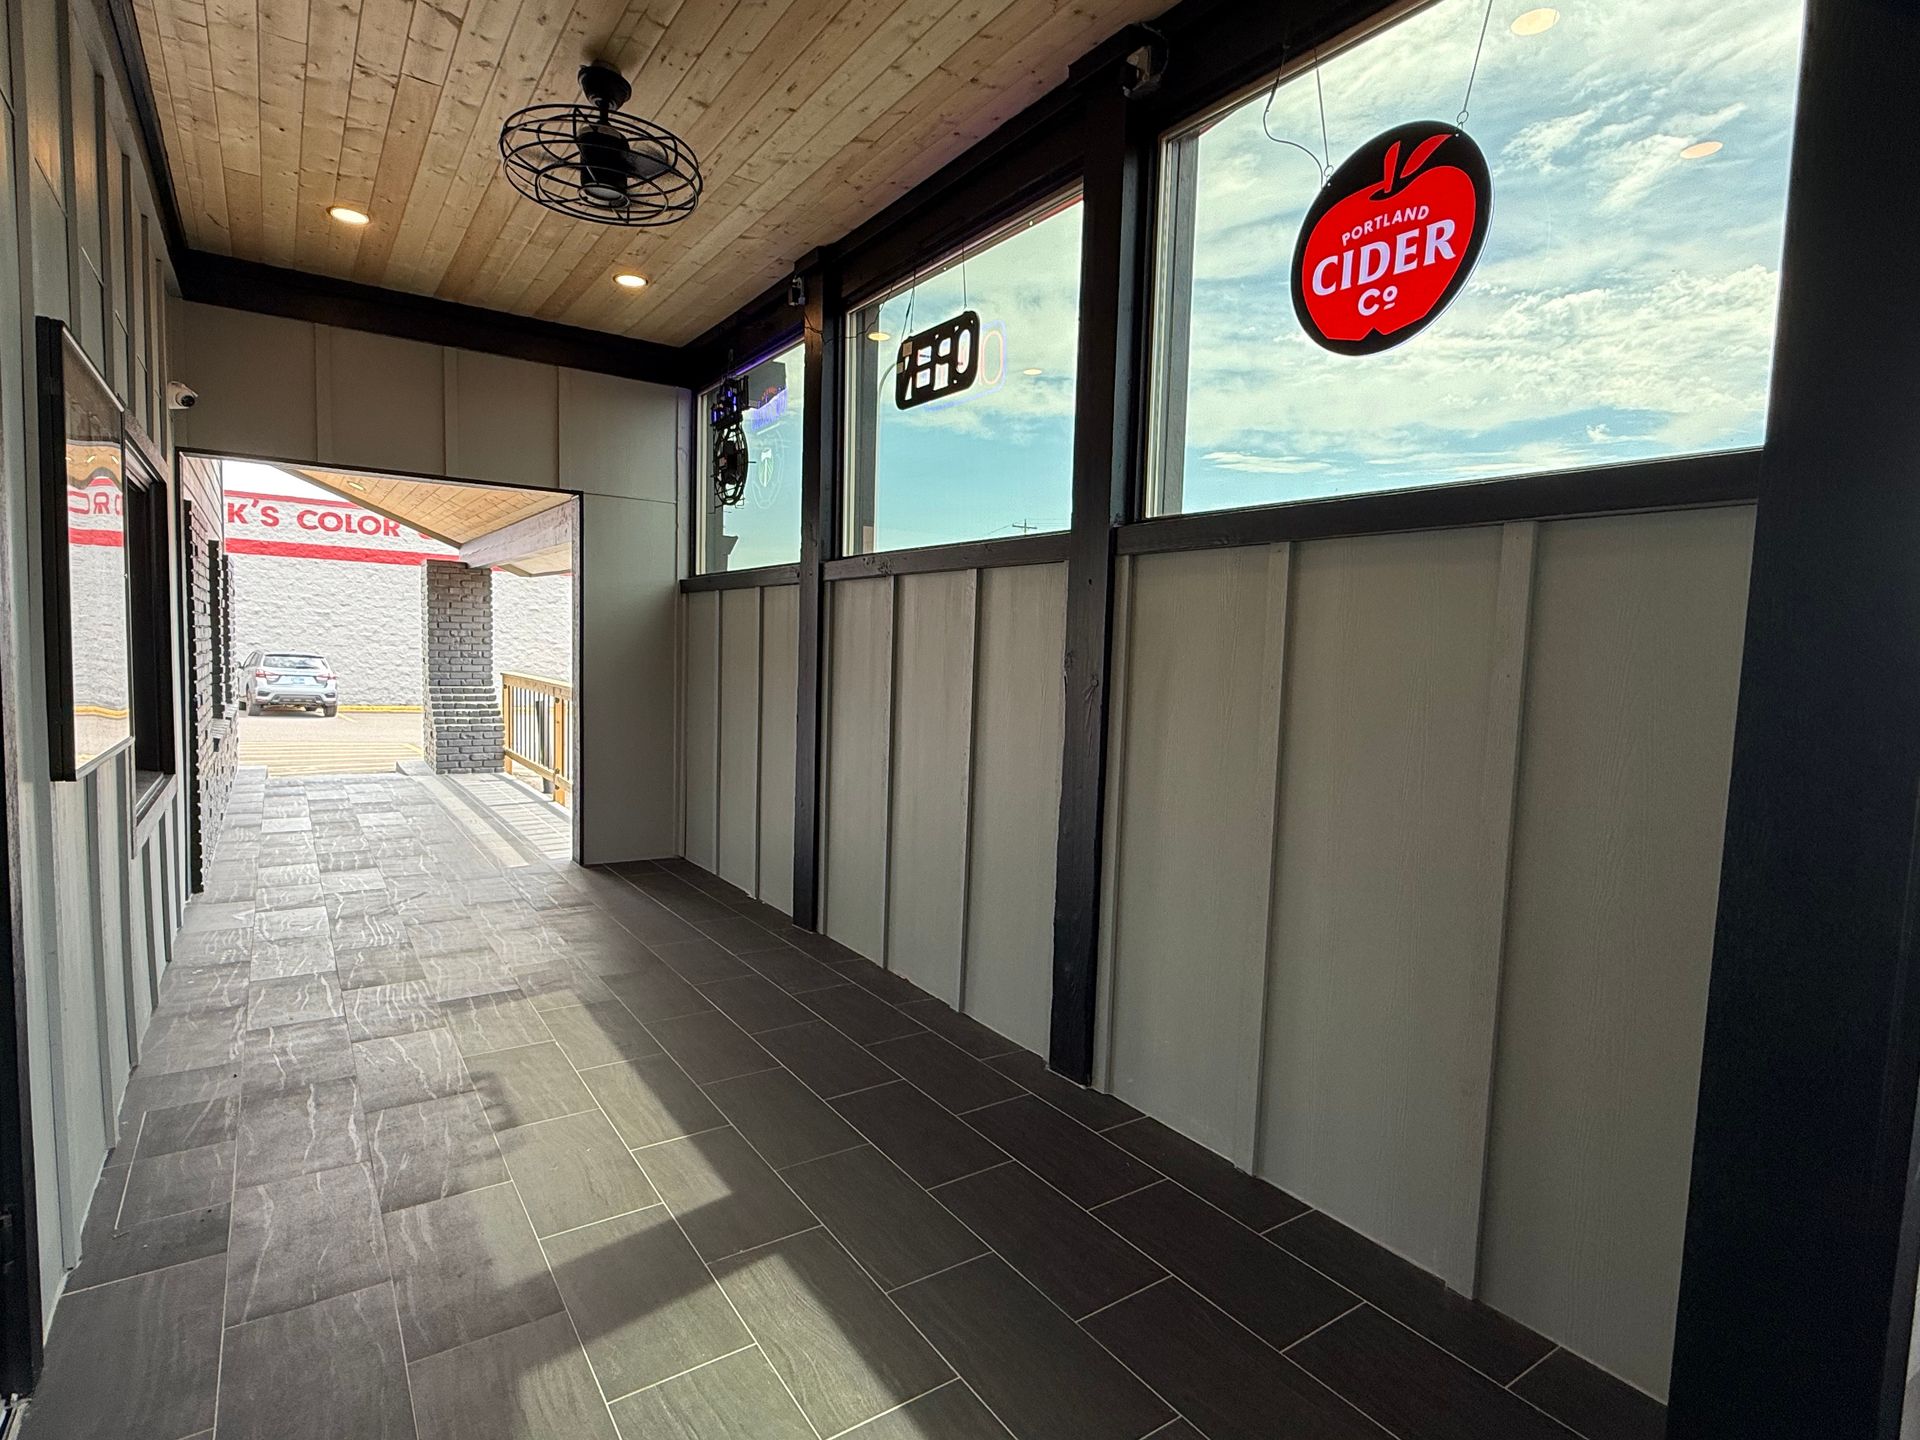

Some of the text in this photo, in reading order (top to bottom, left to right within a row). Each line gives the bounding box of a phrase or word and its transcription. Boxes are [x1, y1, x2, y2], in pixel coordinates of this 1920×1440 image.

[1341, 205, 1430, 247] PORTLAND
[1312, 219, 1457, 297] CIDER
[297, 509, 401, 537] COLOR
